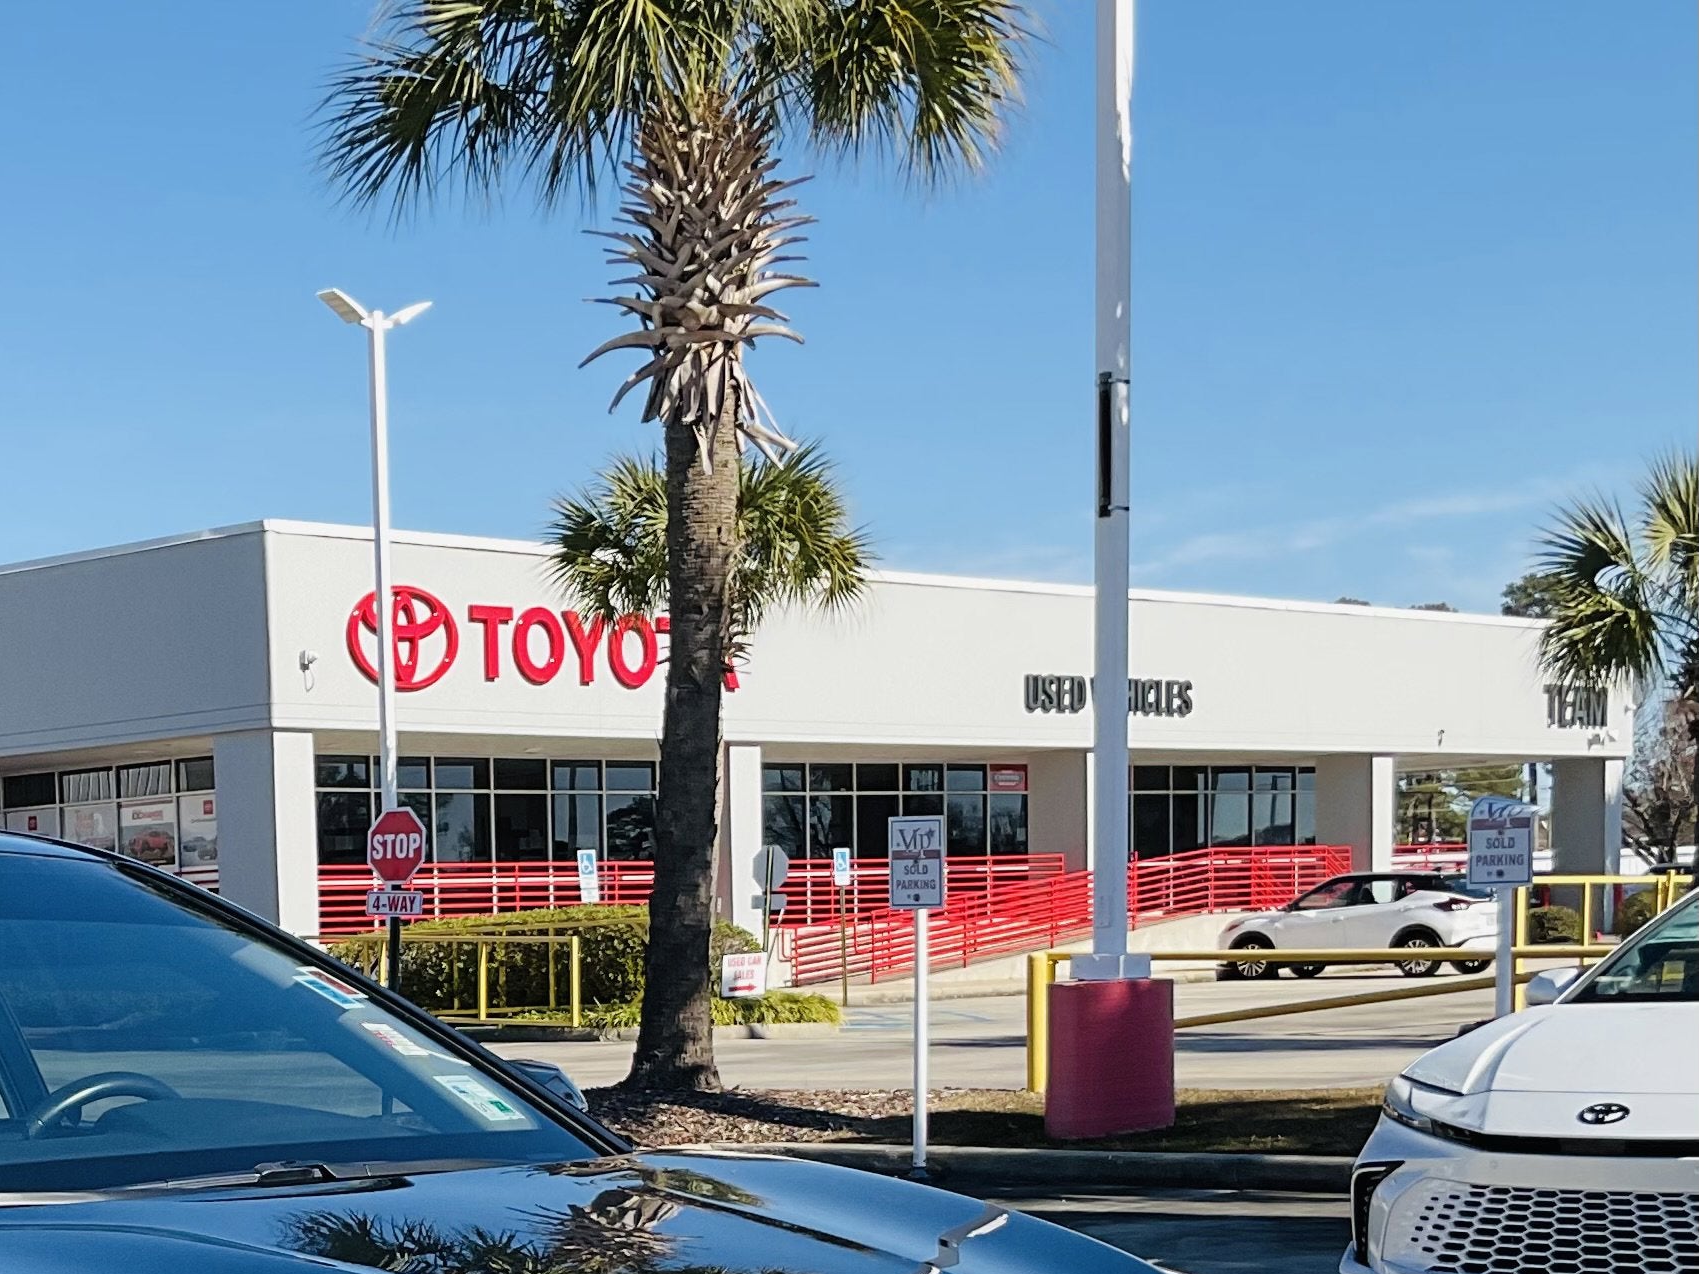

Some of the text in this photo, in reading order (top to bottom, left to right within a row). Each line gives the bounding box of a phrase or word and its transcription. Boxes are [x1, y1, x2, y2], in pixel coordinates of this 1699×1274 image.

[468, 604, 741, 692] TOYO
[1024, 674, 1193, 718] USED HICLES
[1542, 684, 1608, 730] TEAM
[372, 833, 420, 860] STOP
[1486, 836, 1516, 849] SOLD
[1475, 853, 1525, 867] PARKING
[904, 864, 928, 876] SOLD
[896, 879, 936, 890] PARKING
[372, 895, 417, 912] 4-WAY
